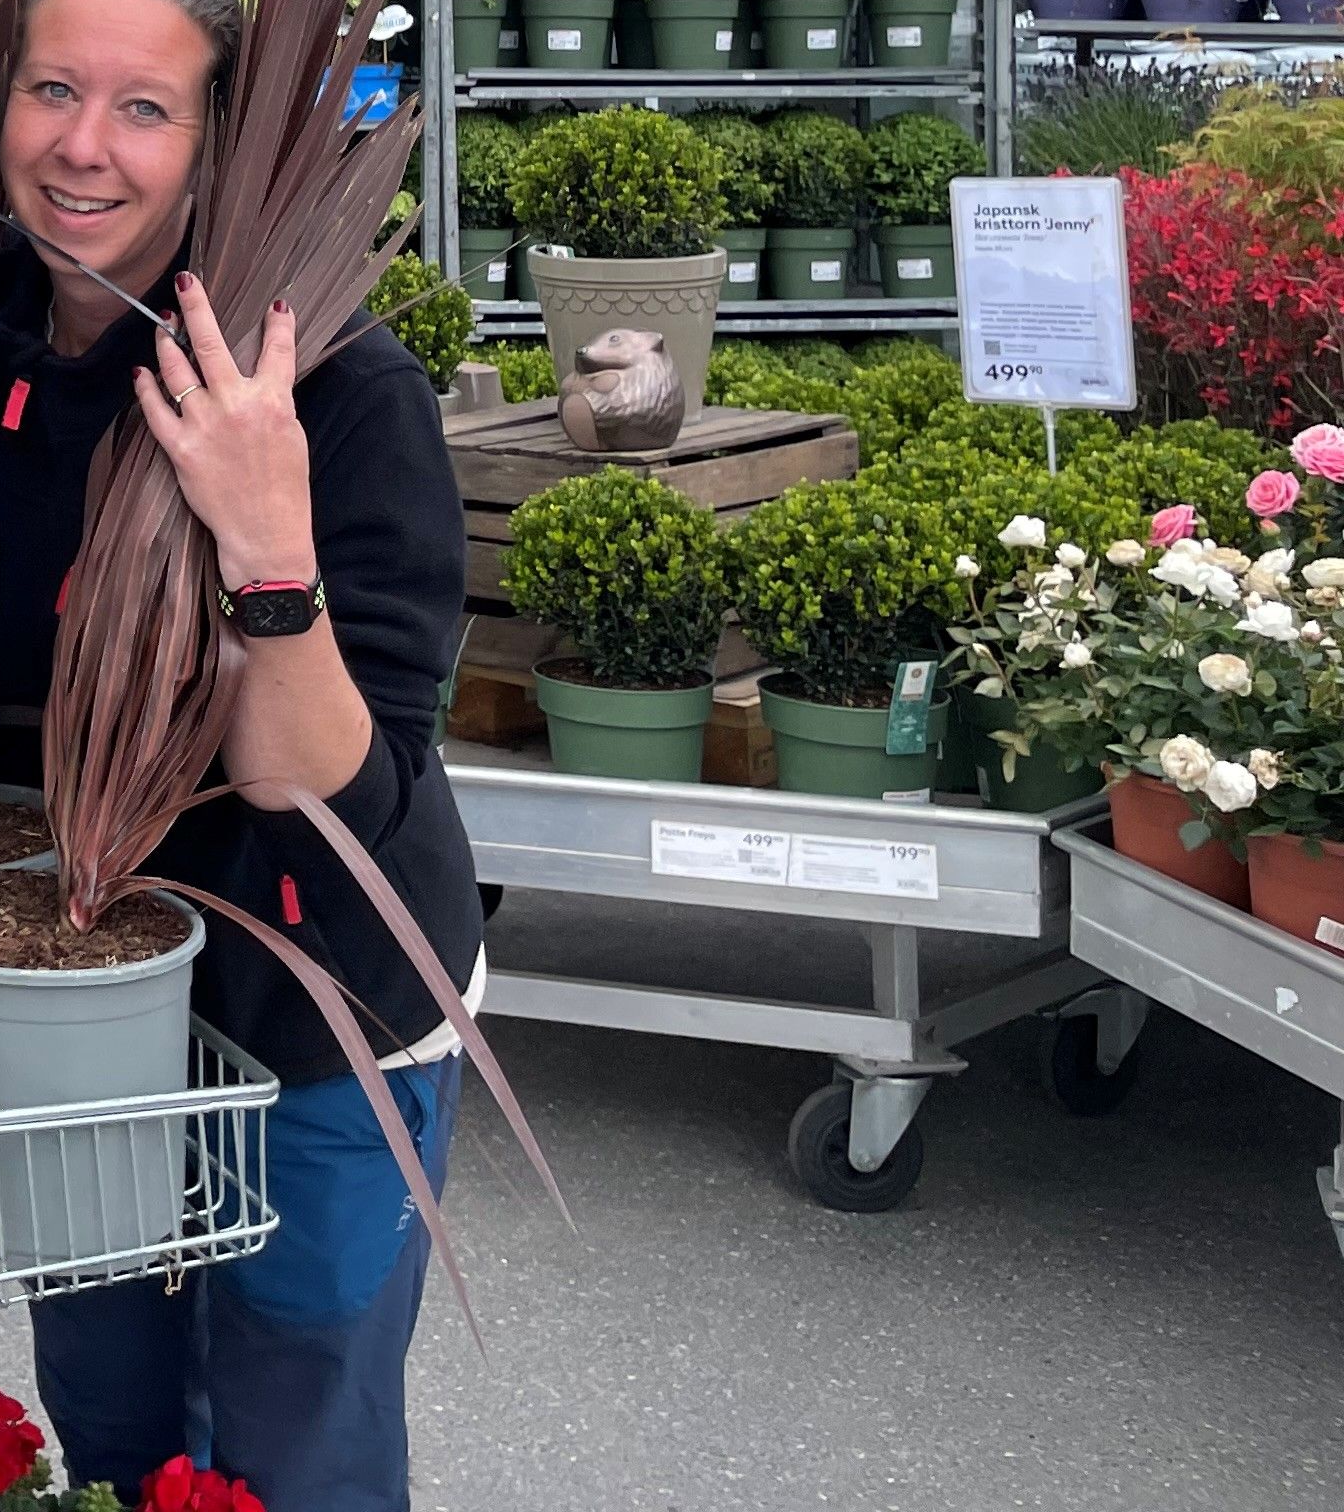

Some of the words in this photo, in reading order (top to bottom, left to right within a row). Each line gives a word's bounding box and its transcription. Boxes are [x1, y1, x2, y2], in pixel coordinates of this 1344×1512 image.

[973, 203, 1040, 218] Japansk
[974, 218, 1041, 230] kristtorn
[1044, 217, 1094, 233] 'Jenny'
[984, 364, 1029, 381] 499
[742, 833, 773, 847] 499
[889, 845, 918, 860] 199
